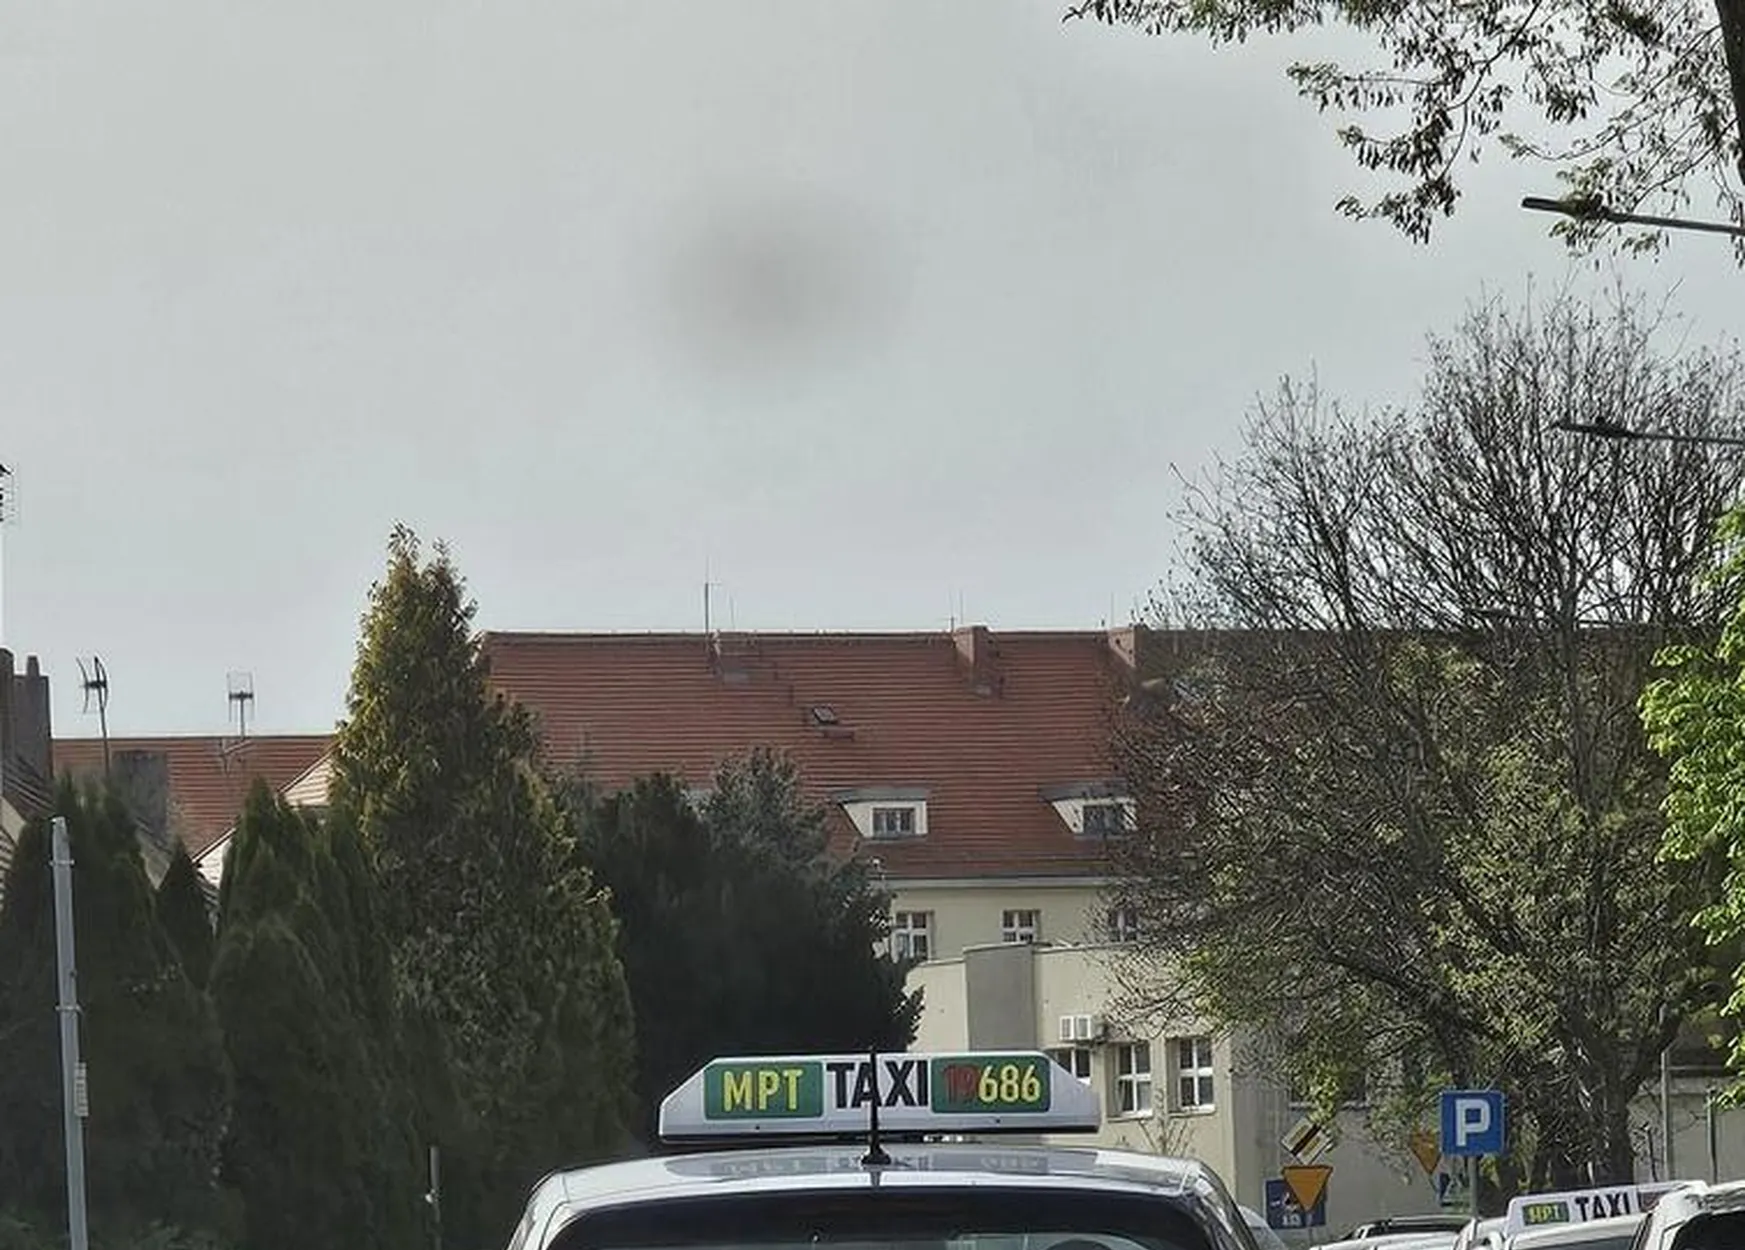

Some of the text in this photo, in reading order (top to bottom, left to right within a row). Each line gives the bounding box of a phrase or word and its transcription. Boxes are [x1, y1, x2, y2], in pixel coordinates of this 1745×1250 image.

[722, 1068, 803, 1112] MPT
[826, 1060, 929, 1109] TAXI
[1455, 1098, 1491, 1147] P
[1574, 1191, 1632, 1222] TAXI
